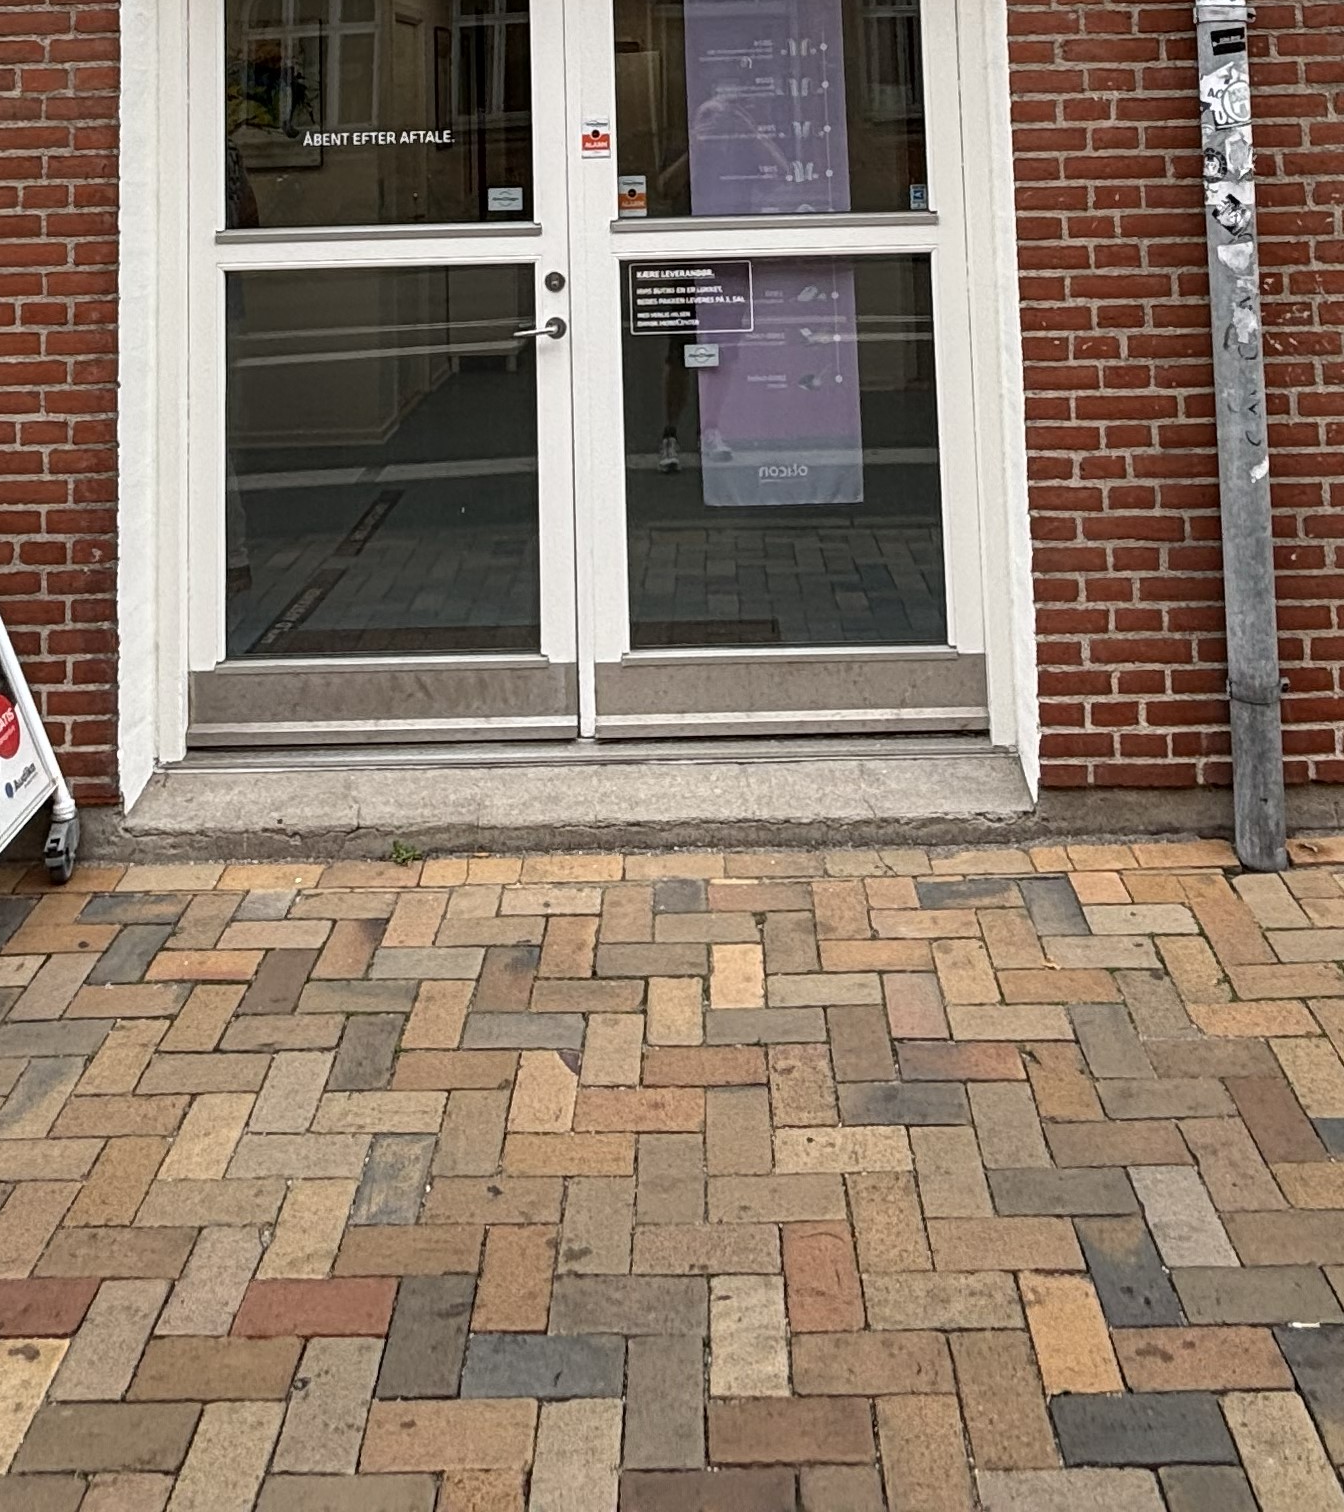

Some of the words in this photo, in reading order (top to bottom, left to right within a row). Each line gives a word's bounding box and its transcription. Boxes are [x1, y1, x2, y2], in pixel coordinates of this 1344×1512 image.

[303, 131, 349, 146] ÅBENT
[352, 132, 396, 145] EFTER
[399, 130, 455, 144] AFTALE.
